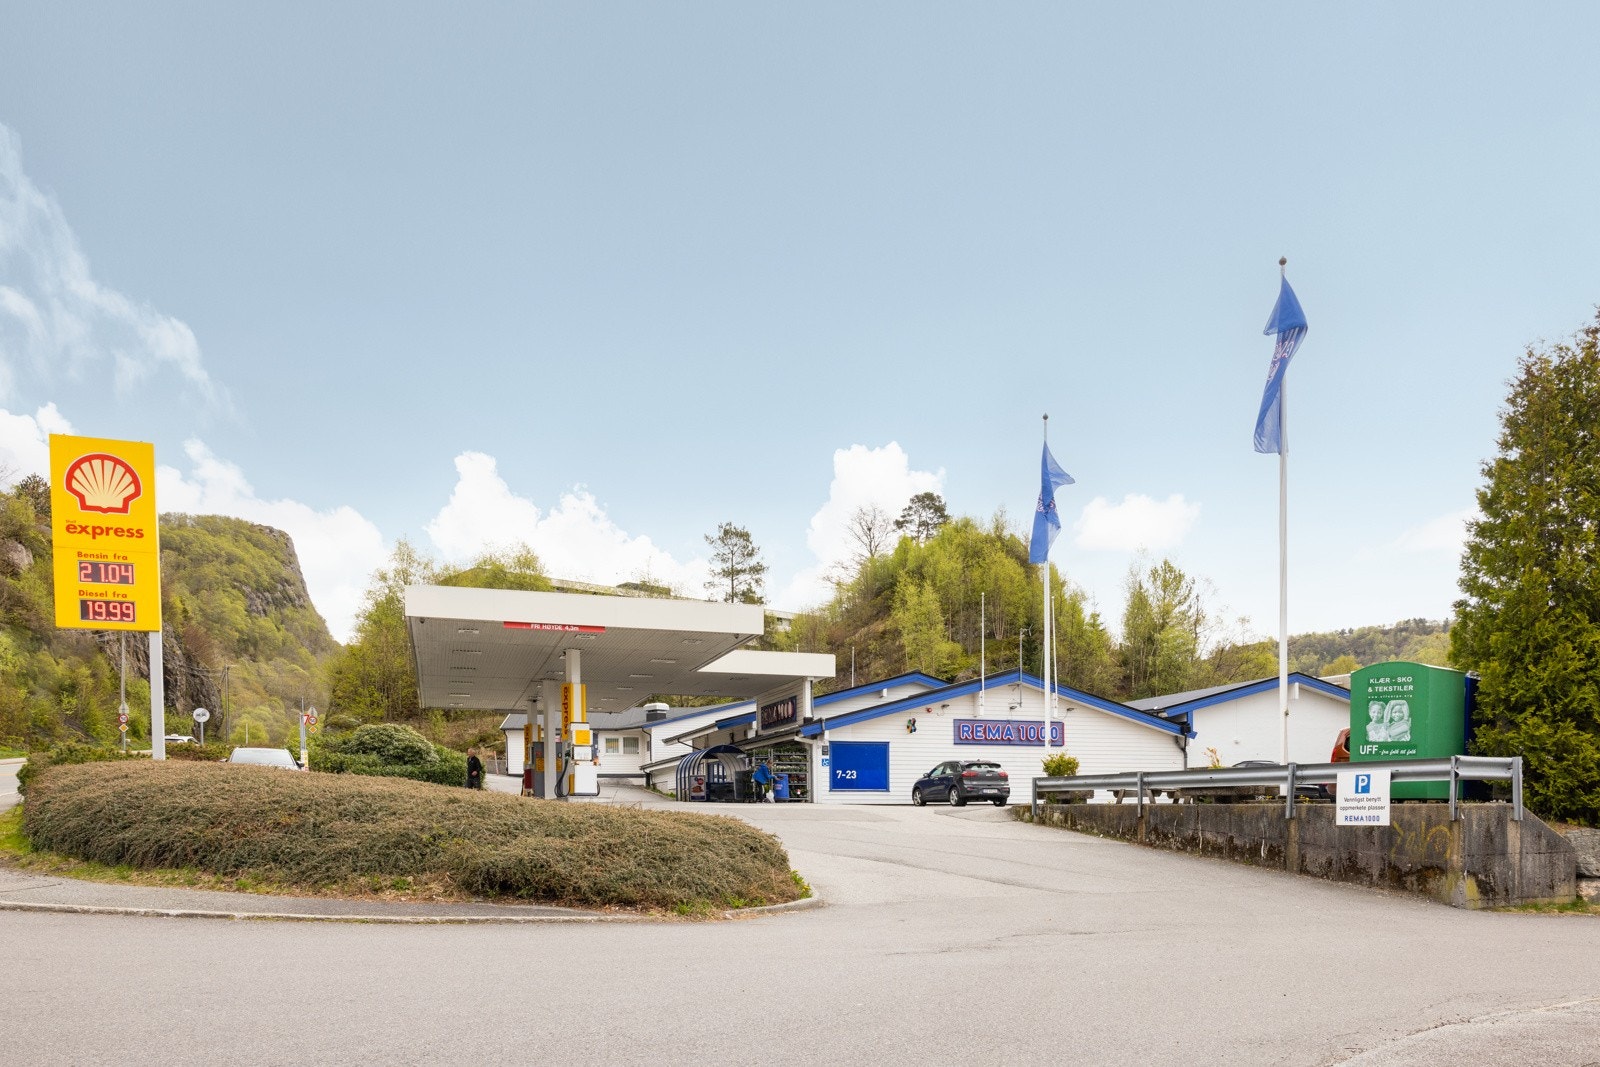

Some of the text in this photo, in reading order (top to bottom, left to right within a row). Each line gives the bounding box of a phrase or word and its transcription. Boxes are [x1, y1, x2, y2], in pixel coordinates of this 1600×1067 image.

[66, 524, 144, 540] express
[77, 551, 108, 559] Bensin
[87, 601, 134, 621] 19.99
[960, 724, 1059, 741] REMA 1000
[1360, 745, 1378, 754] UFF
[836, 770, 857, 779] 7-23
